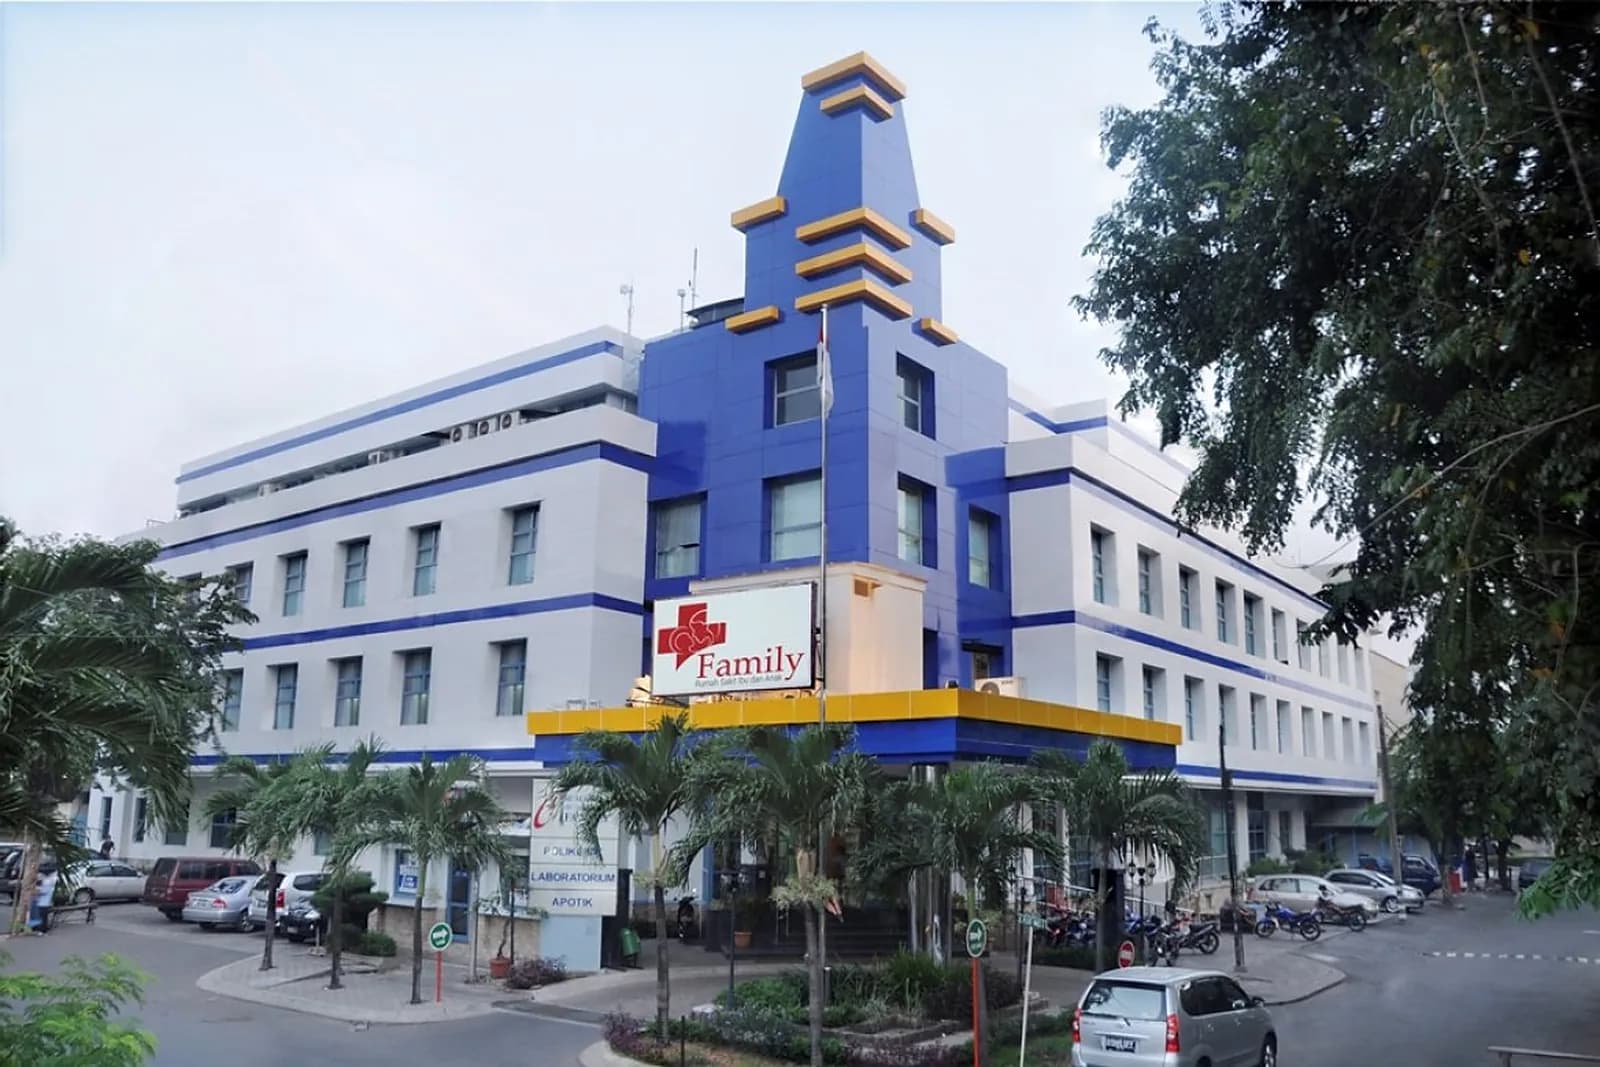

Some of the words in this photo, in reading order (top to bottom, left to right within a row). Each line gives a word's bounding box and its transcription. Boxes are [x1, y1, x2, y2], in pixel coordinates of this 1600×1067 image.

[697, 645, 804, 681] Family
[531, 872, 616, 881] LABORATORIUM
[552, 897, 593, 907] APOTIK
